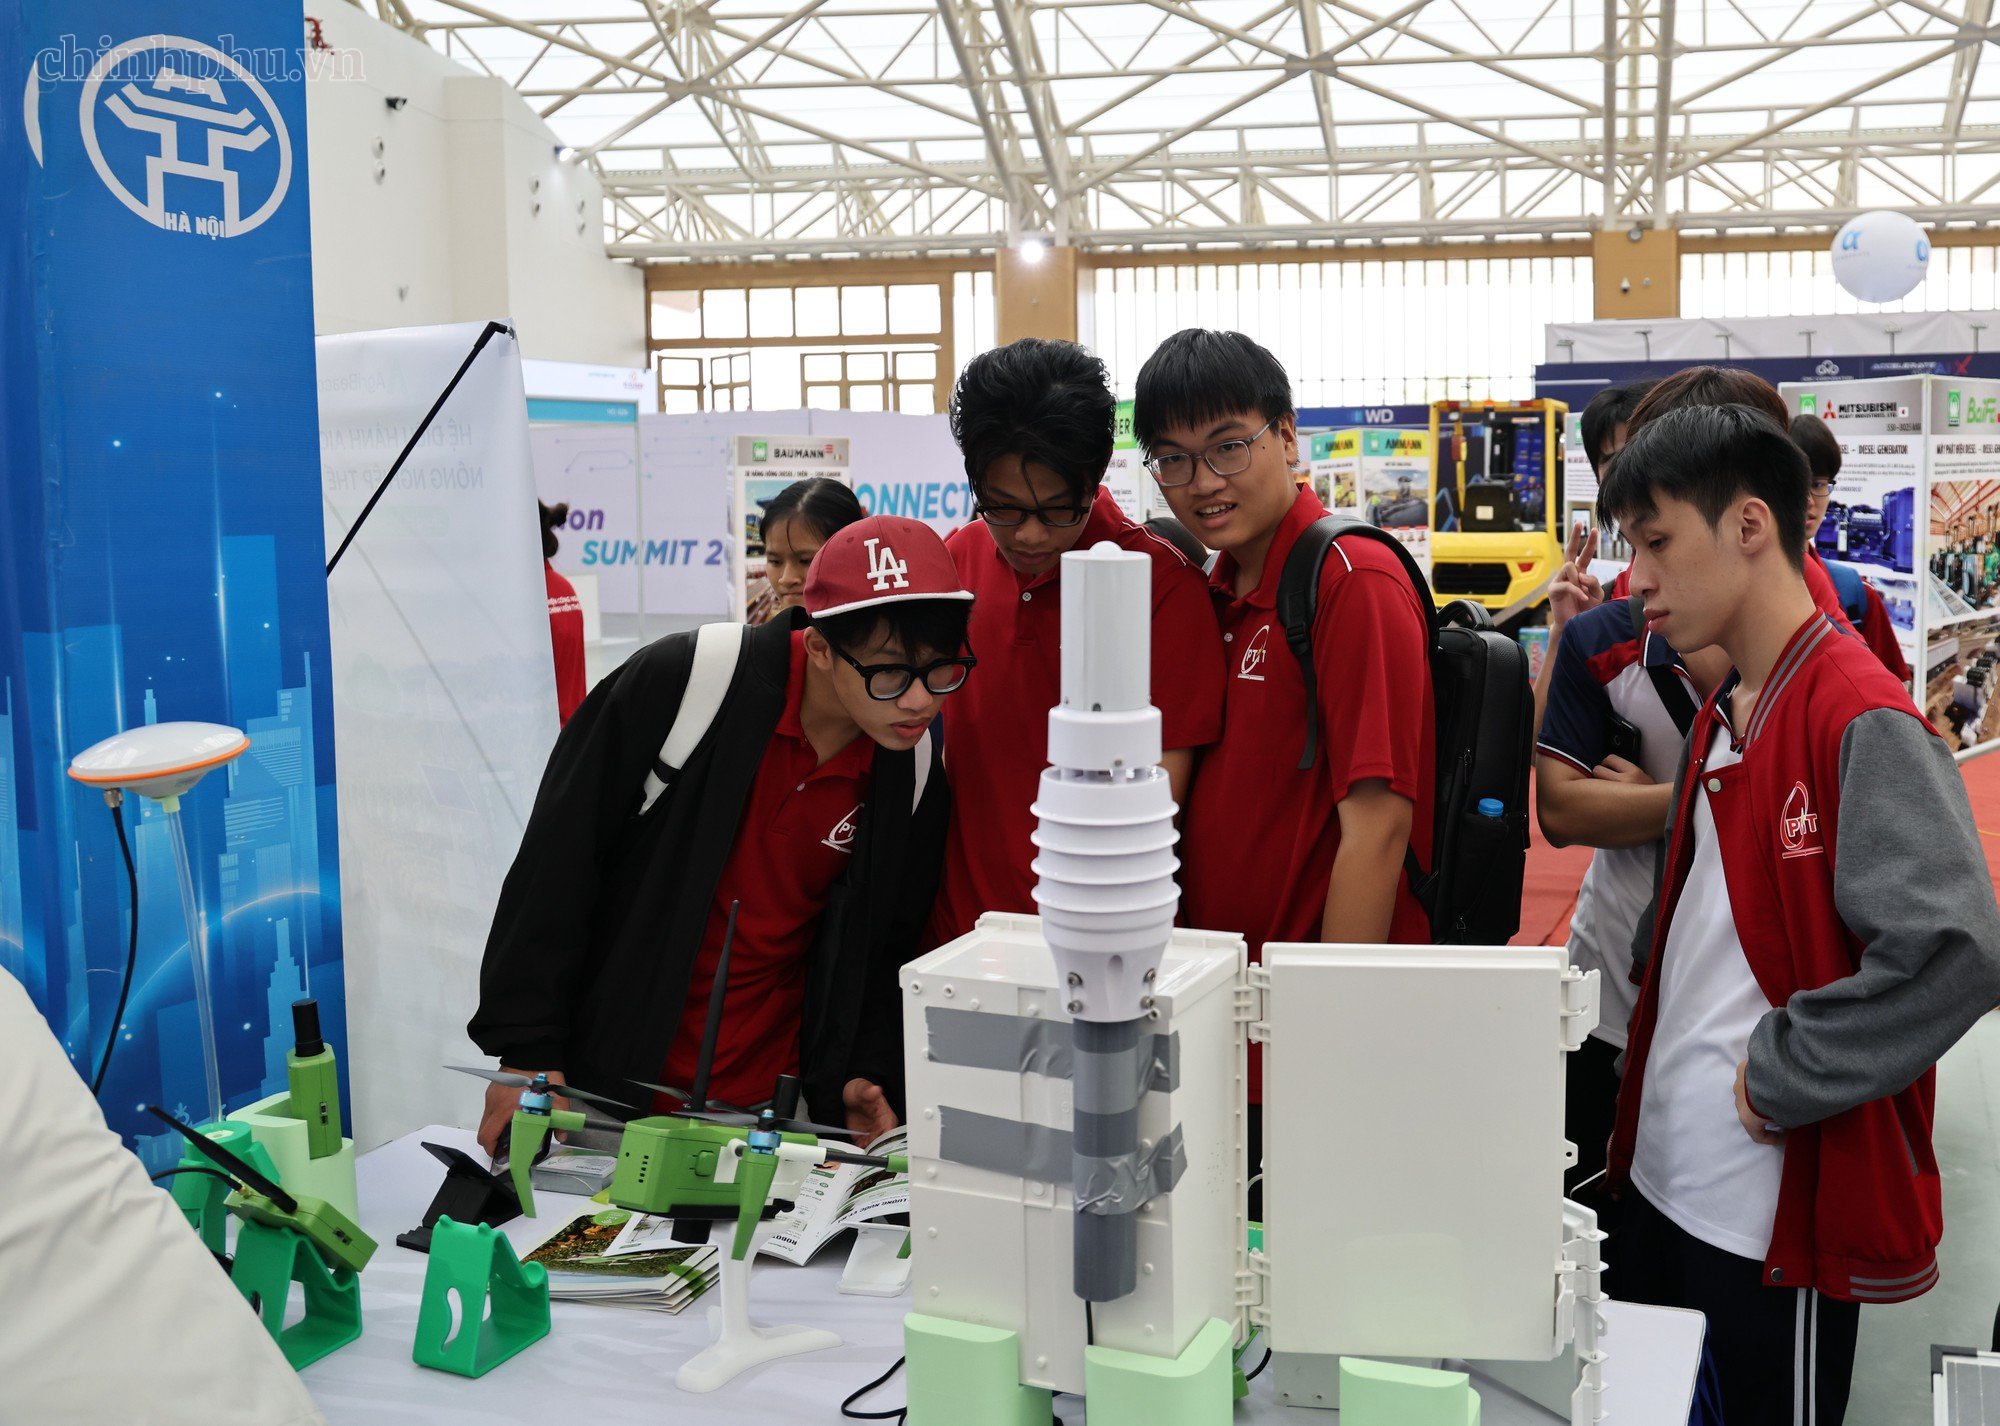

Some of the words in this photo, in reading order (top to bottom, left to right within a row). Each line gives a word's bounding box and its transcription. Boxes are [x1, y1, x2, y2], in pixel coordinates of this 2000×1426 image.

[164, 210, 191, 233] HÀ
[195, 215, 226, 241] NỘI
[1838, 402, 1897, 413] MITSUBISHI
[1325, 439, 1354, 452] AMMANN
[1385, 438, 1422, 450] AMMANN
[774, 448, 824, 458] BAUMANN
[556, 509, 604, 530] on
[581, 540, 698, 566] SUMMIT
[863, 538, 910, 591] LA
